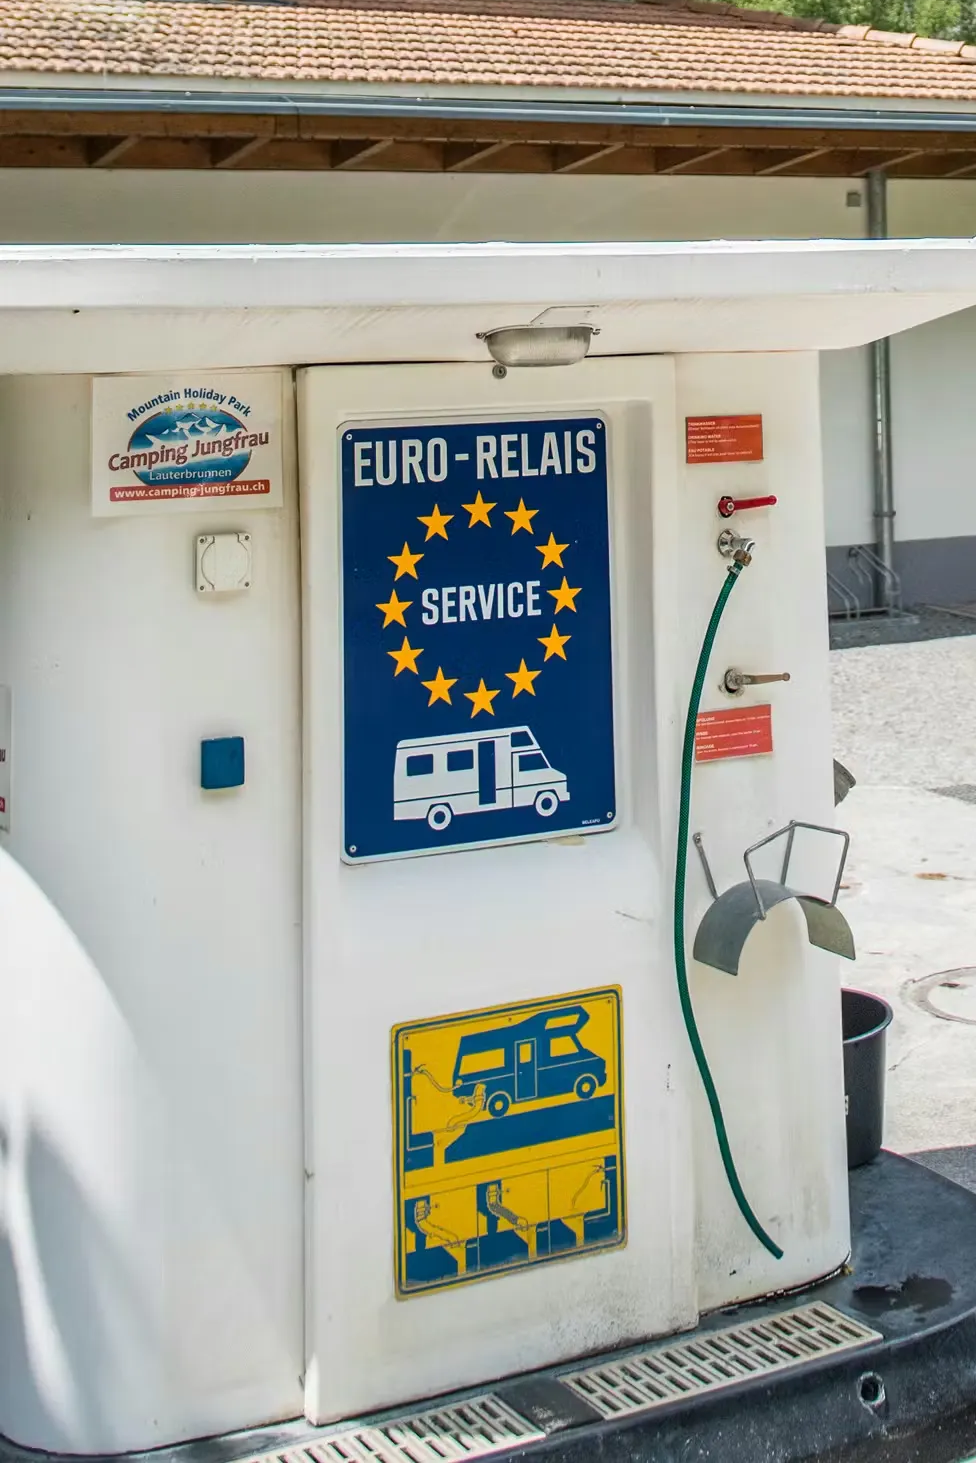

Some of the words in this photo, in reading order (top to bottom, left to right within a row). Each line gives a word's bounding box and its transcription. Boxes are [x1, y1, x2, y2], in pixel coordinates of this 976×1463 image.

[127, 390, 180, 422] Mountain
[184, 388, 226, 405] Holiday
[228, 396, 251, 418] Park
[108, 444, 188, 471] Camping
[192, 431, 269, 457] Jungfrau
[115, 482, 264, 498] www.camping-jungfrau.ch
[150, 469, 231, 481] Lauterbrunnen
[422, 580, 541, 625] SERVICE
